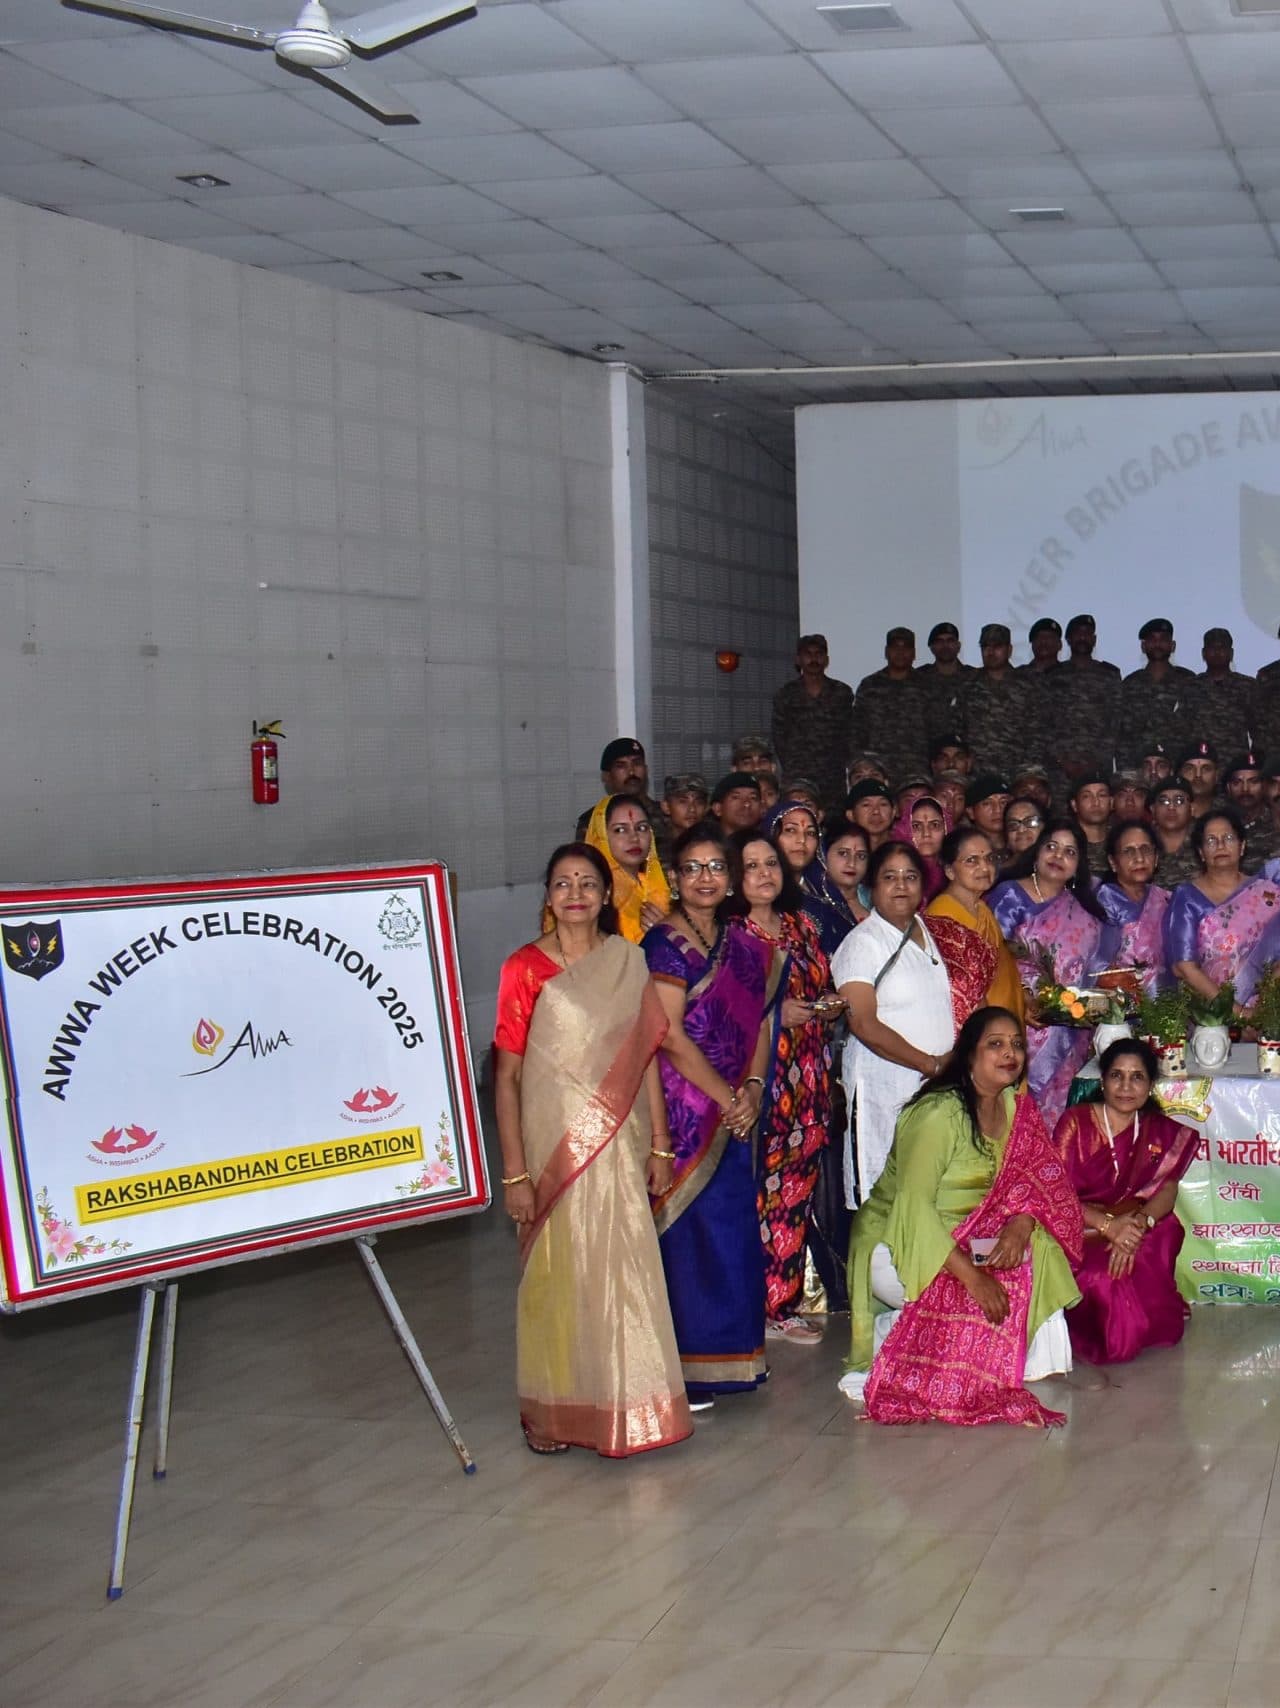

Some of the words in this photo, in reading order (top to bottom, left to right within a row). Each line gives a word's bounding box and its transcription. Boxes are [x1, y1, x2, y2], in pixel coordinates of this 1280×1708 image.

[1064, 421, 1225, 543] BRIGADE
[43, 1000, 101, 1100] AWWA
[89, 926, 178, 997] WEEK
[182, 911, 382, 989] CELEBRATION
[377, 987, 424, 1050] 2025
[87, 1160, 280, 1209] RAKSHABANDHAN
[284, 1134, 415, 1173] CELEBRATION
[1218, 1180, 1262, 1201] राँची
[1191, 1259, 1264, 1275] स्थापना
